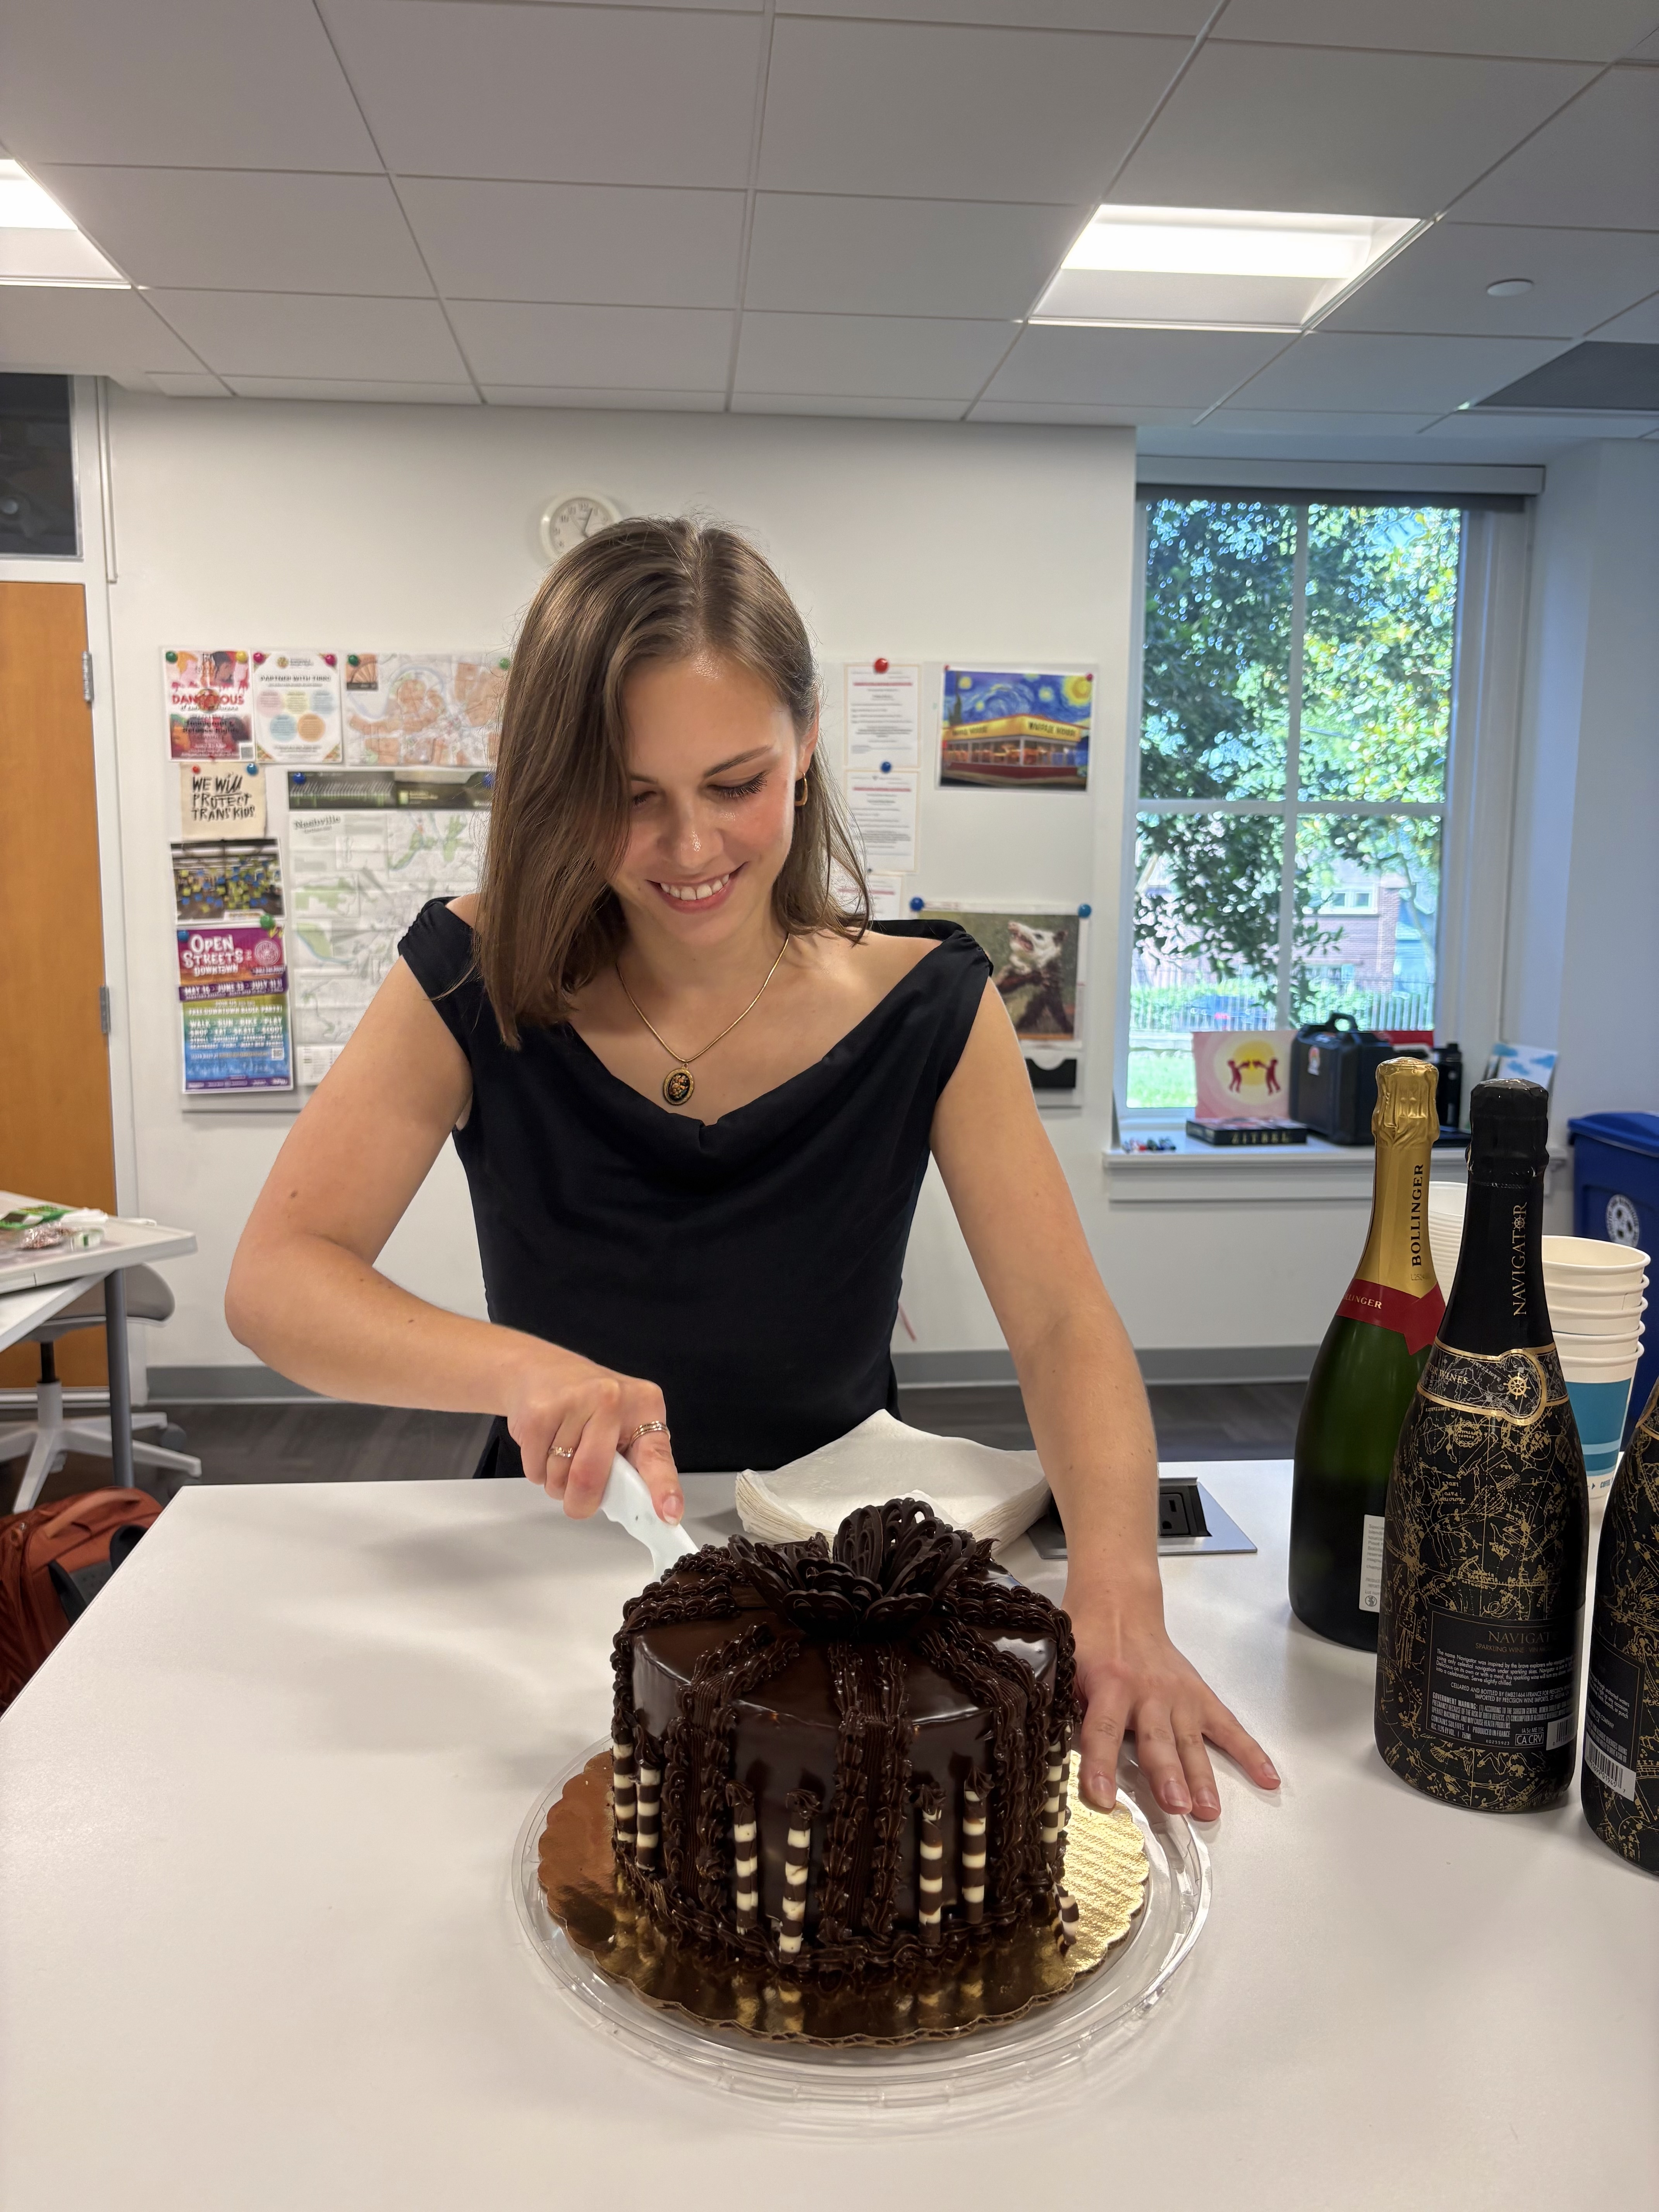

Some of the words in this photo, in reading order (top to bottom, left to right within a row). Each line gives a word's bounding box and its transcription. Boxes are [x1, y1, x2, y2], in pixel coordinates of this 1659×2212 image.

[193, 776, 212, 792] WE
[193, 793, 252, 810] PROTECT
[191, 808, 231, 822] TRANS
[233, 805, 255, 820] KIDS
[191, 934, 234, 955] OPEN
[182, 947, 244, 968] STREETS
[194, 963, 239, 977] DOWNTOWN
[217, 983, 235, 993] JUNE
[190, 1018, 210, 1028] WALK
[263, 1016, 282, 1025] PLAY
[1411, 1164, 1424, 1267] BOLLINGER
[1511, 1202, 1527, 1316] NAVIGATOR
[1439, 1369, 1468, 1384] WINES
[1488, 1631, 1551, 1644] NAVIGAT
[1475, 1643, 1507, 1652] SPARKLING
[1436, 1660, 1453, 1670] Delicious
[1456, 1654, 1477, 1664] Navigator
[1447, 1670, 1470, 1680] celebration.
[1451, 1682, 1469, 1691] CELLARED
[1432, 1699, 1448, 1709] PREGNANCY
[1449, 1704, 1461, 1714] BECAUSE
[1433, 1692, 1456, 1705] GOVERNMENT
[1458, 1700, 1478, 1710] WARNING:
[1484, 1705, 1501, 1713] ACCORDING
[1432, 1706, 1443, 1716] OPERATE
[1444, 1710, 1460, 1721] MACHINERY,
[1431, 1714, 1448, 1726] CONTAINS
[1448, 1720, 1464, 1731] SULFITES
[1473, 1726, 1491, 1735] PRODUCED
[1462, 1732, 1471, 1740] 750ML
[1516, 1736, 1527, 1744] CA
[1528, 1734, 1542, 1743] CRV
